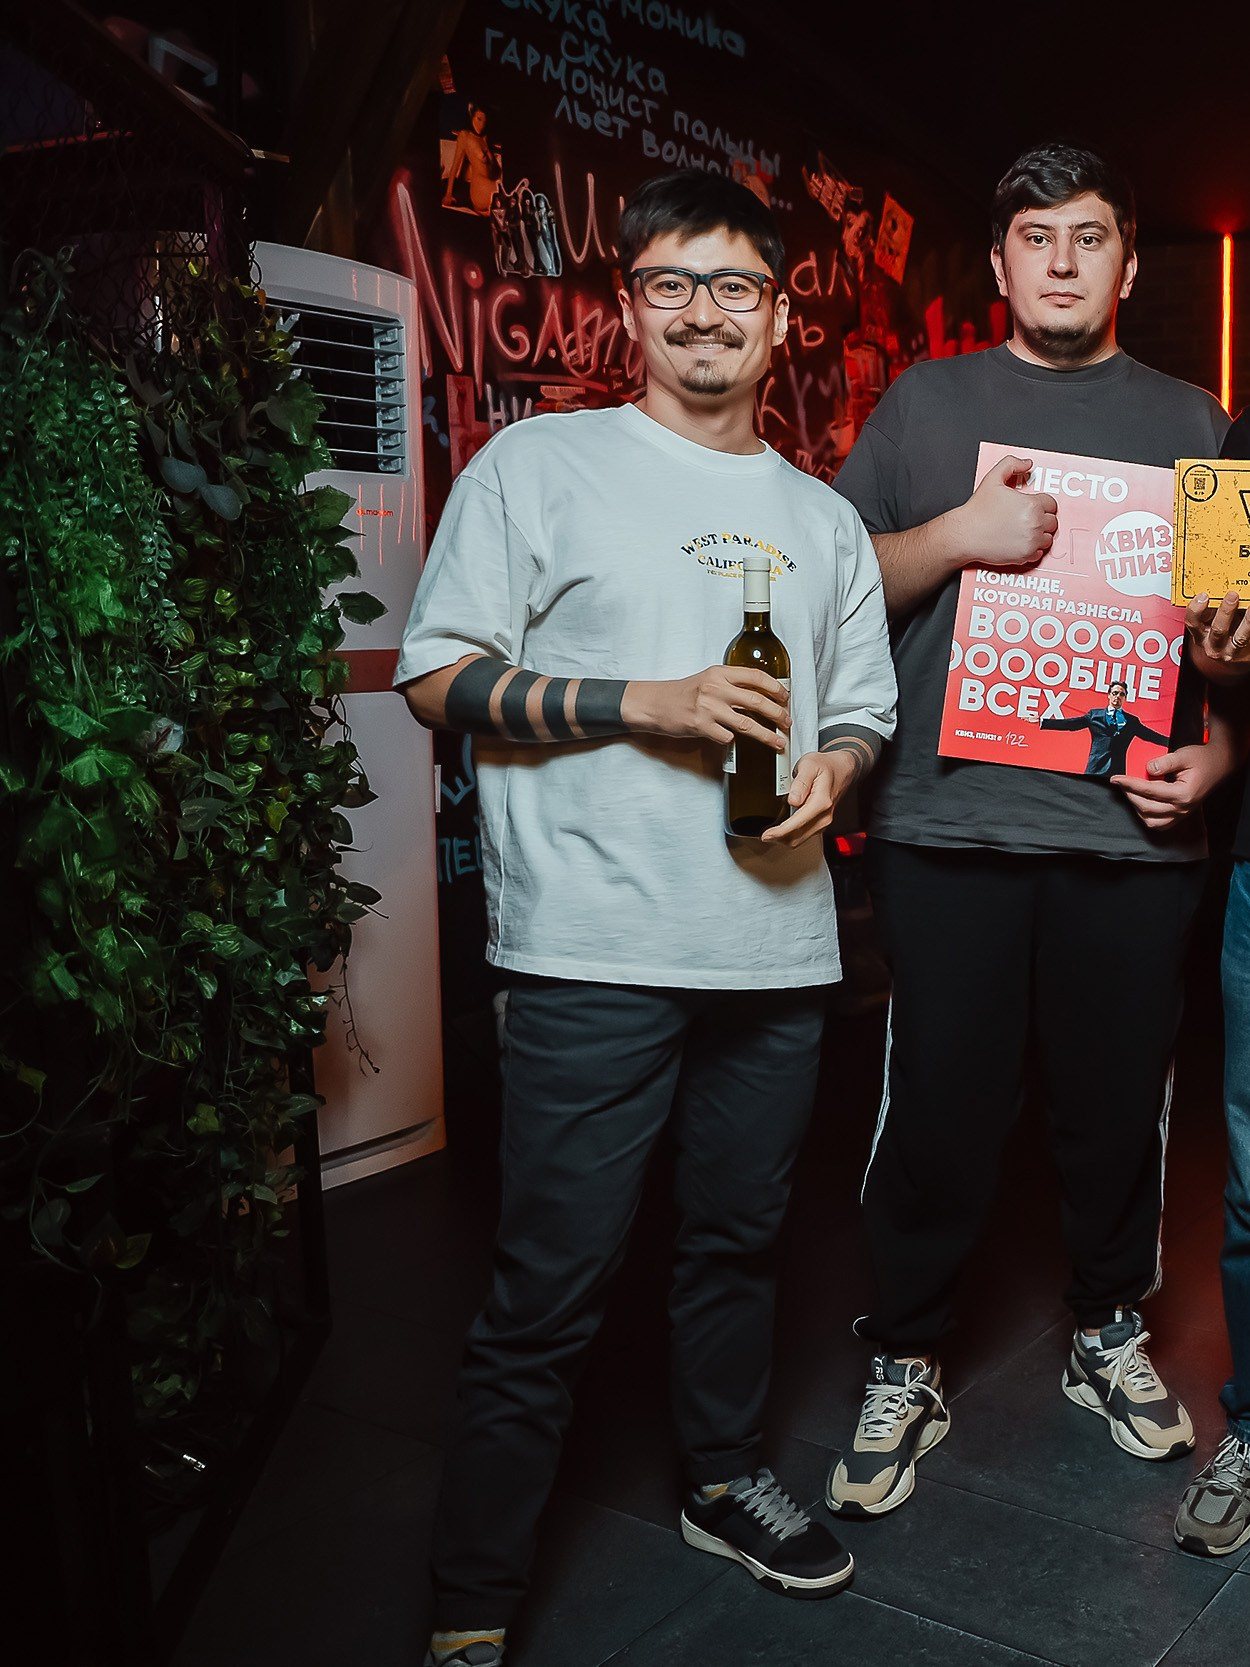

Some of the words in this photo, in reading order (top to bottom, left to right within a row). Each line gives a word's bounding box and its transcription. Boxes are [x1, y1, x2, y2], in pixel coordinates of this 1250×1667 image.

[681, 533, 718, 555] WEST
[721, 532, 797, 573] PARADISE
[975, 569, 1065, 596] КОМАНДЕ,
[972, 588, 1053, 612] КОТОРАЯ
[1055, 600, 1143, 624] РАЗНЕСЛА
[958, 678, 1071, 721] ВСЕХ
[1005, 731, 1029, 747] 122
